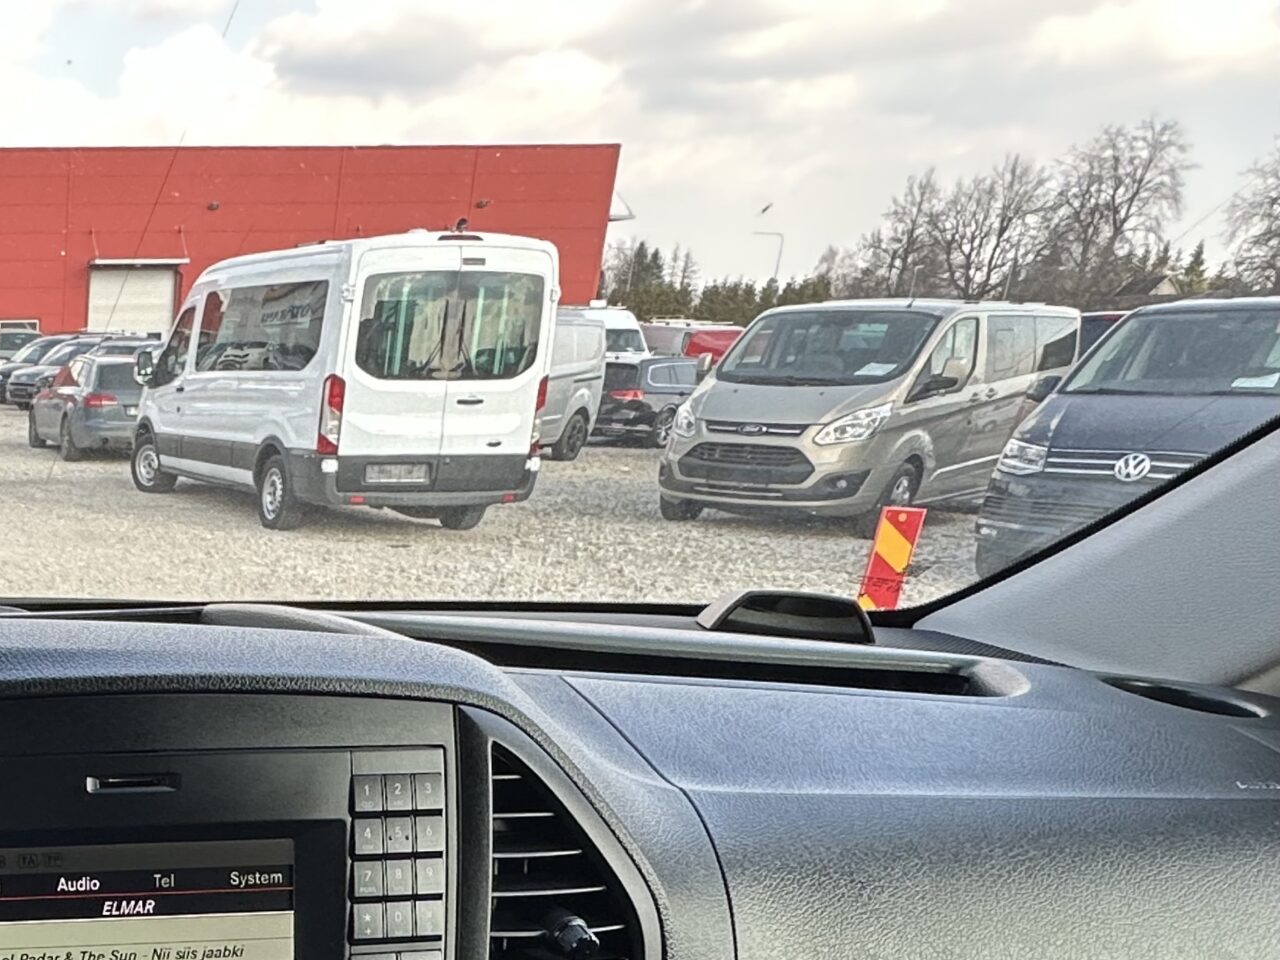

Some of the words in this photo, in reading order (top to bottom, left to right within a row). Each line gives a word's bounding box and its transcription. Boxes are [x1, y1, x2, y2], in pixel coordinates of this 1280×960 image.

[363, 784, 370, 797] 1
[394, 782, 403, 795] 2
[423, 782, 432, 794] 3
[363, 827, 372, 840] 4
[394, 826, 402, 838] 5
[425, 825, 433, 837] 6
[363, 870, 372, 881] 7
[395, 868, 403, 880] 8
[425, 866, 434, 877] 9
[56, 876, 100, 892] Audio
[153, 873, 175, 888] Tel
[229, 871, 283, 888] System
[102, 899, 156, 915] ELMAR
[394, 911, 402, 922] 0
[174, 947, 198, 960] siis
